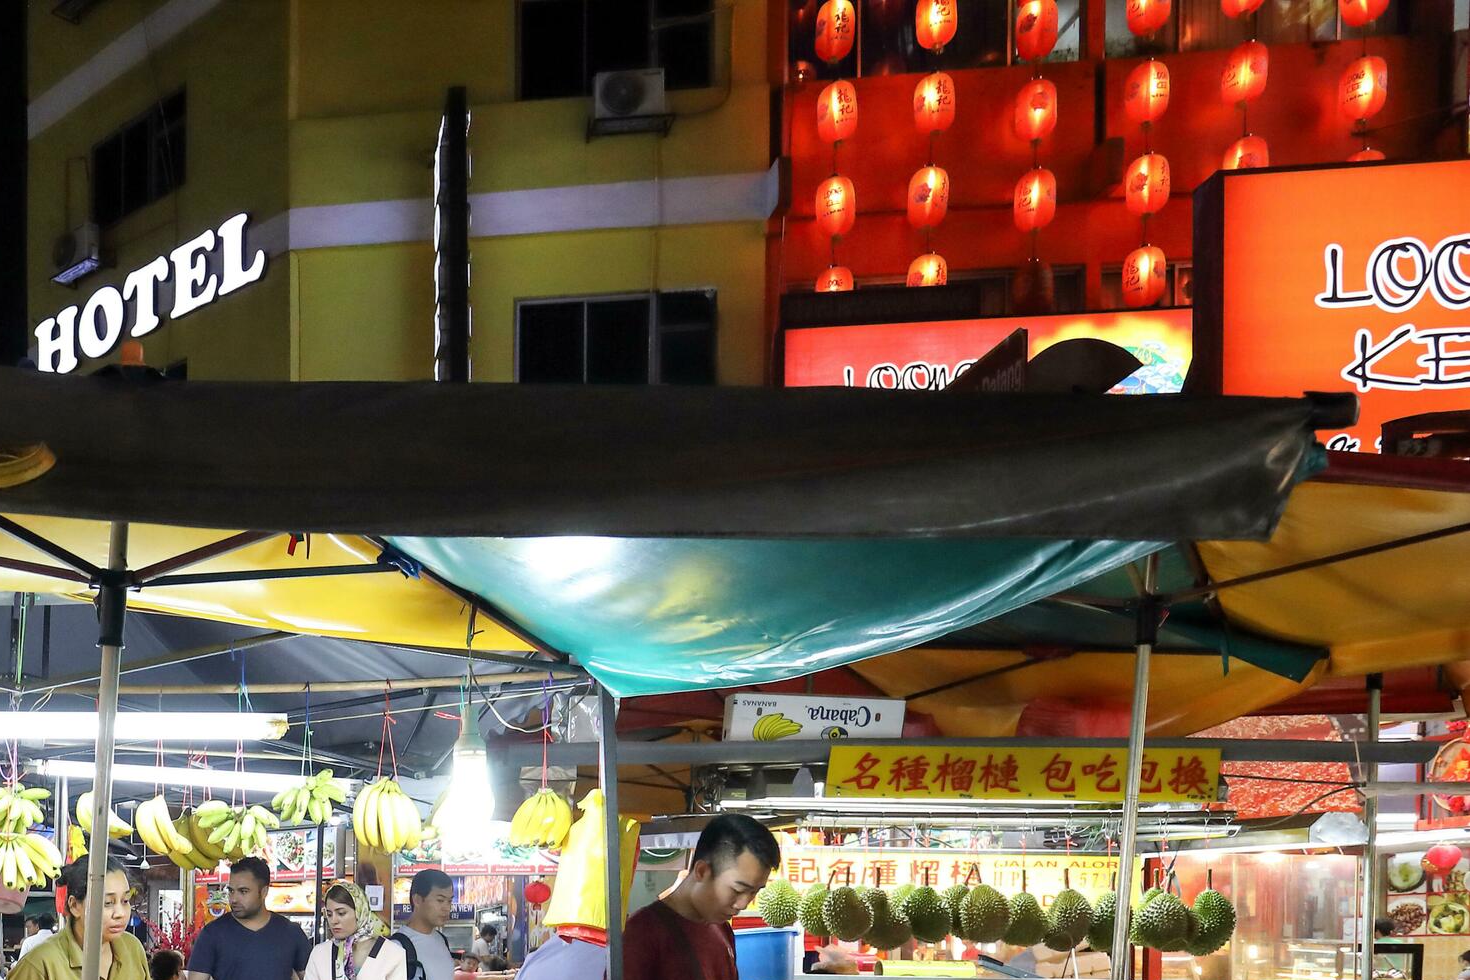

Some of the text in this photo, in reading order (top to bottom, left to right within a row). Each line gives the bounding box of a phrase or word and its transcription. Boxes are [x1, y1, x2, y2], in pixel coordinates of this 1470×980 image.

[33, 211, 268, 375] HOTEL
[742, 699, 778, 707] BANANAS
[807, 705, 872, 728] Cabana
[458, 904, 473, 913] VIEW
